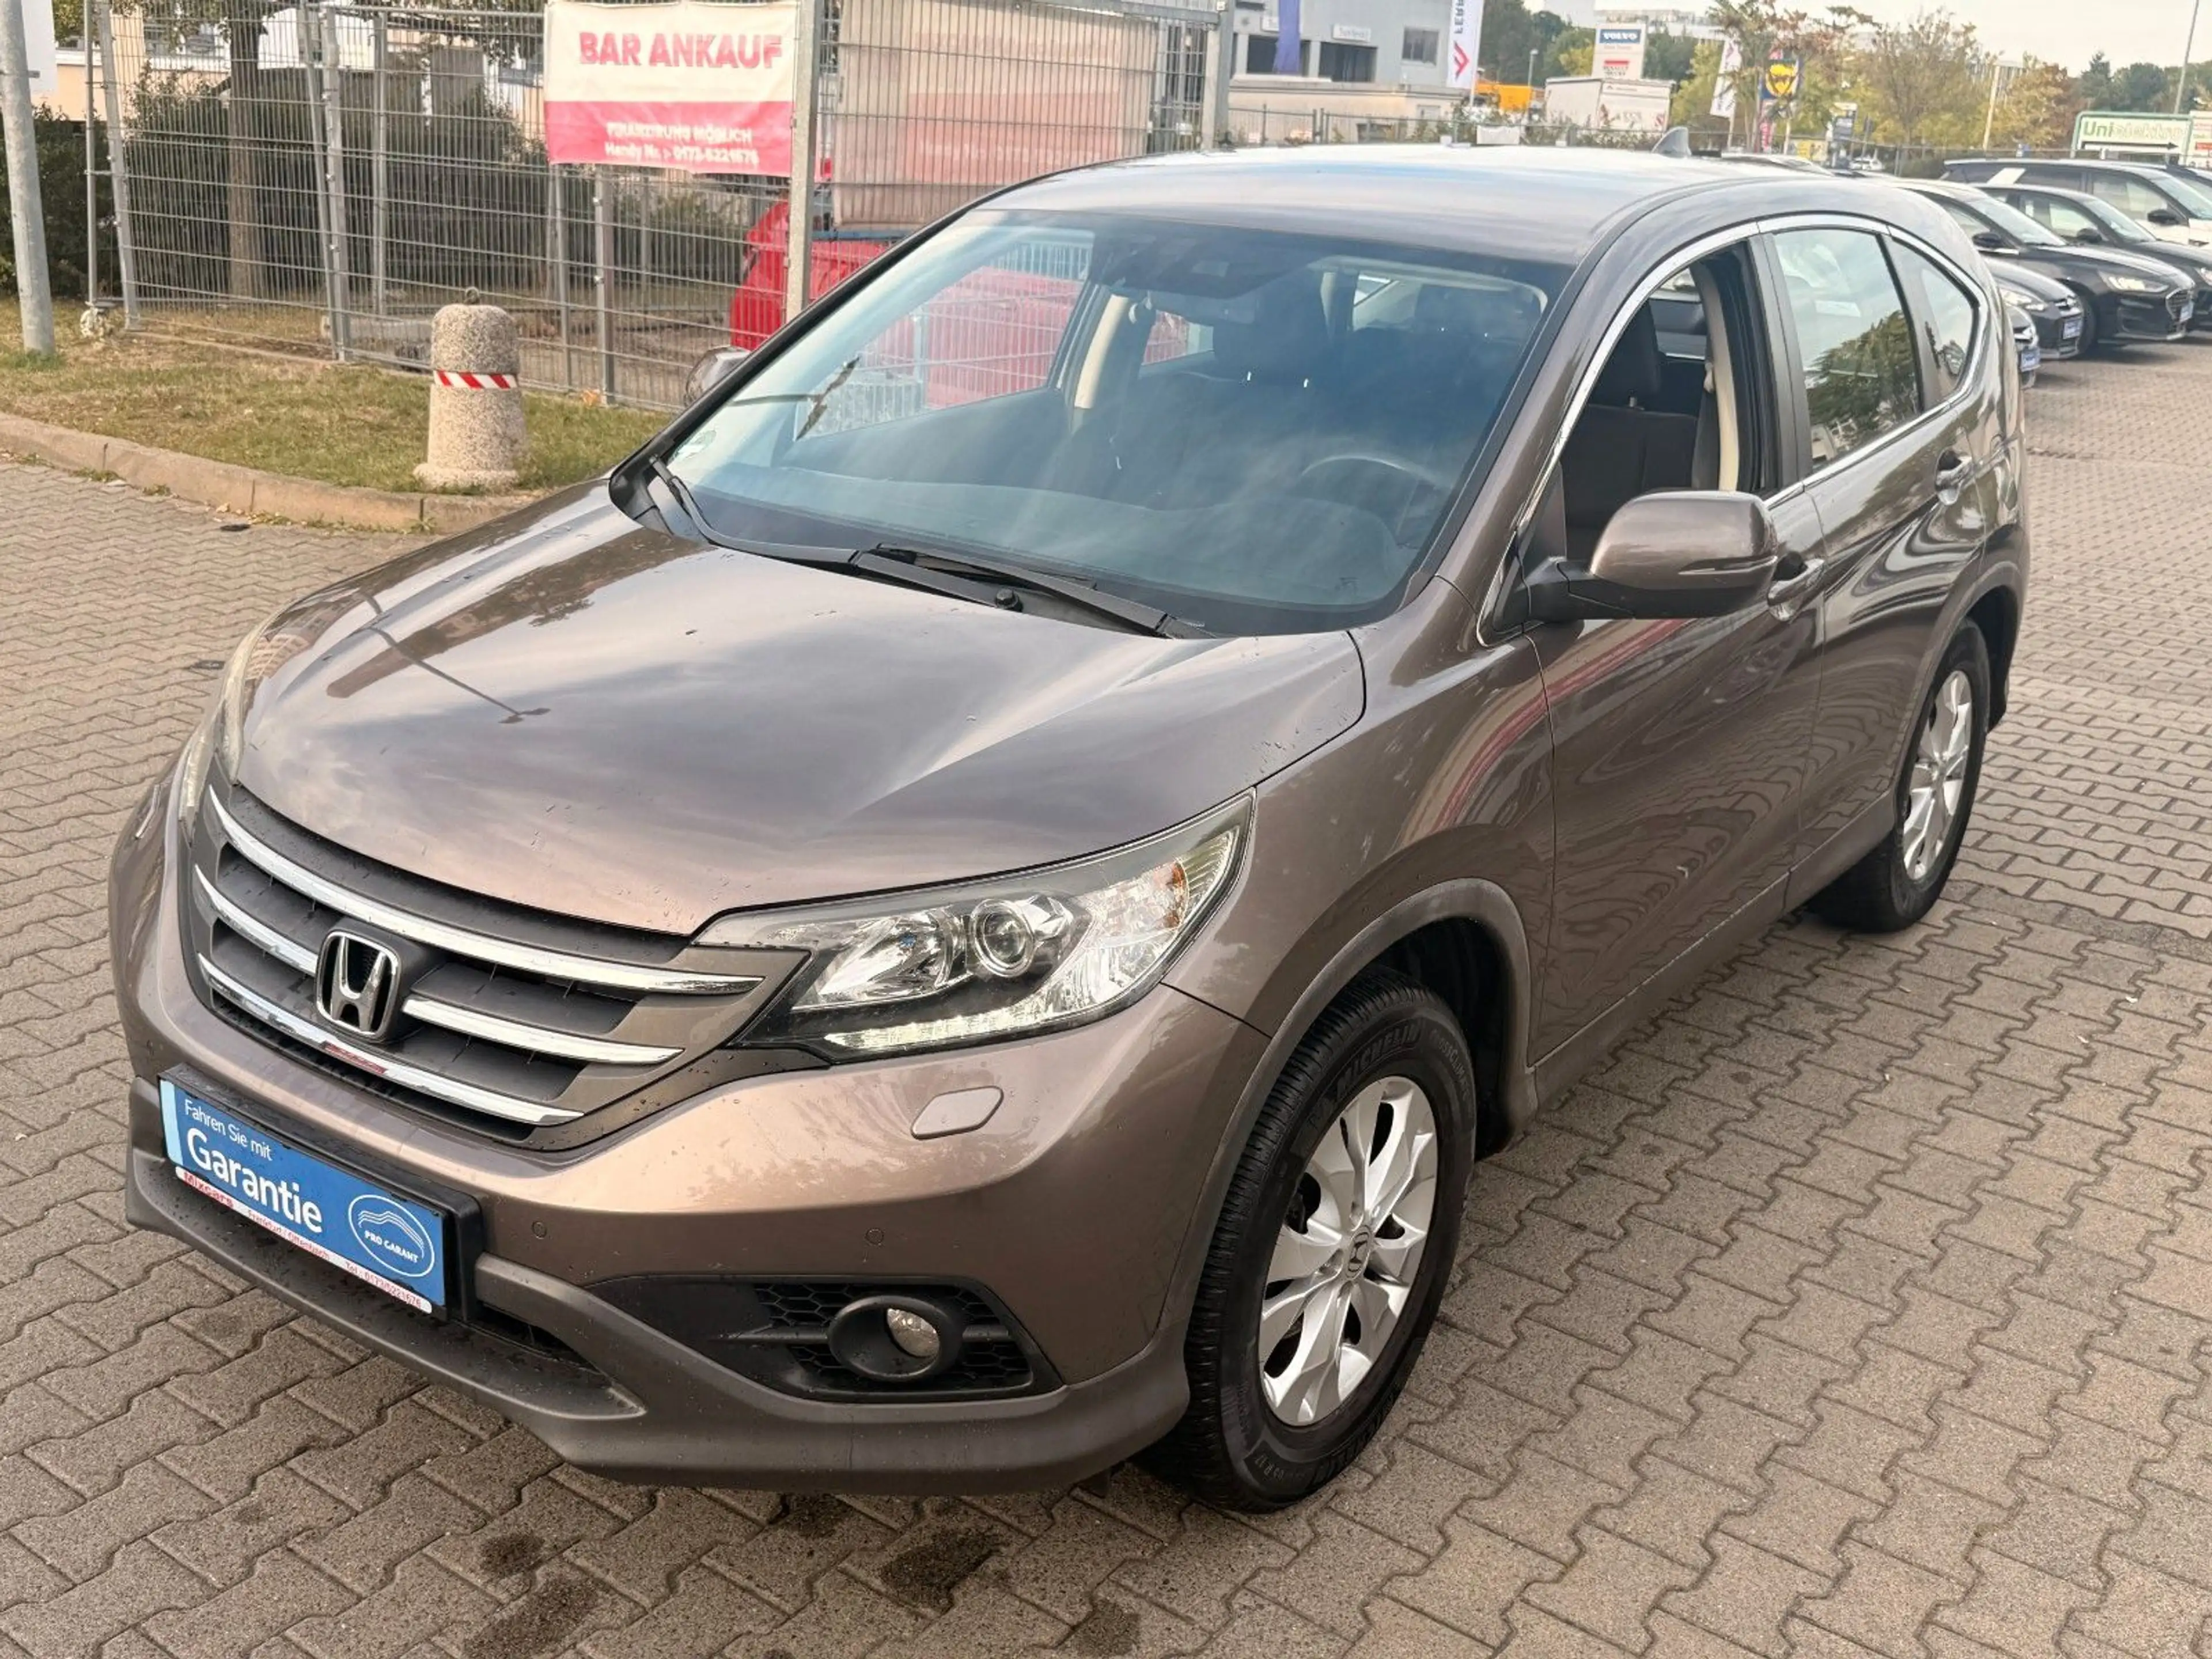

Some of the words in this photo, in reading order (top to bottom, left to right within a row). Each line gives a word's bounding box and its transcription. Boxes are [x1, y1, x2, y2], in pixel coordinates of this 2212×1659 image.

[579, 32, 642, 66] BAR
[649, 33, 782, 69] ANKAUF
[1603, 32, 1638, 41] VOLVO
[185, 1099, 226, 1135] Fahren
[228, 1123, 248, 1147] Sie
[251, 1140, 273, 1161] mit
[187, 1127, 323, 1233] Garantie
[364, 1230, 382, 1245] PRO
[384, 1240, 419, 1263] GARANT
